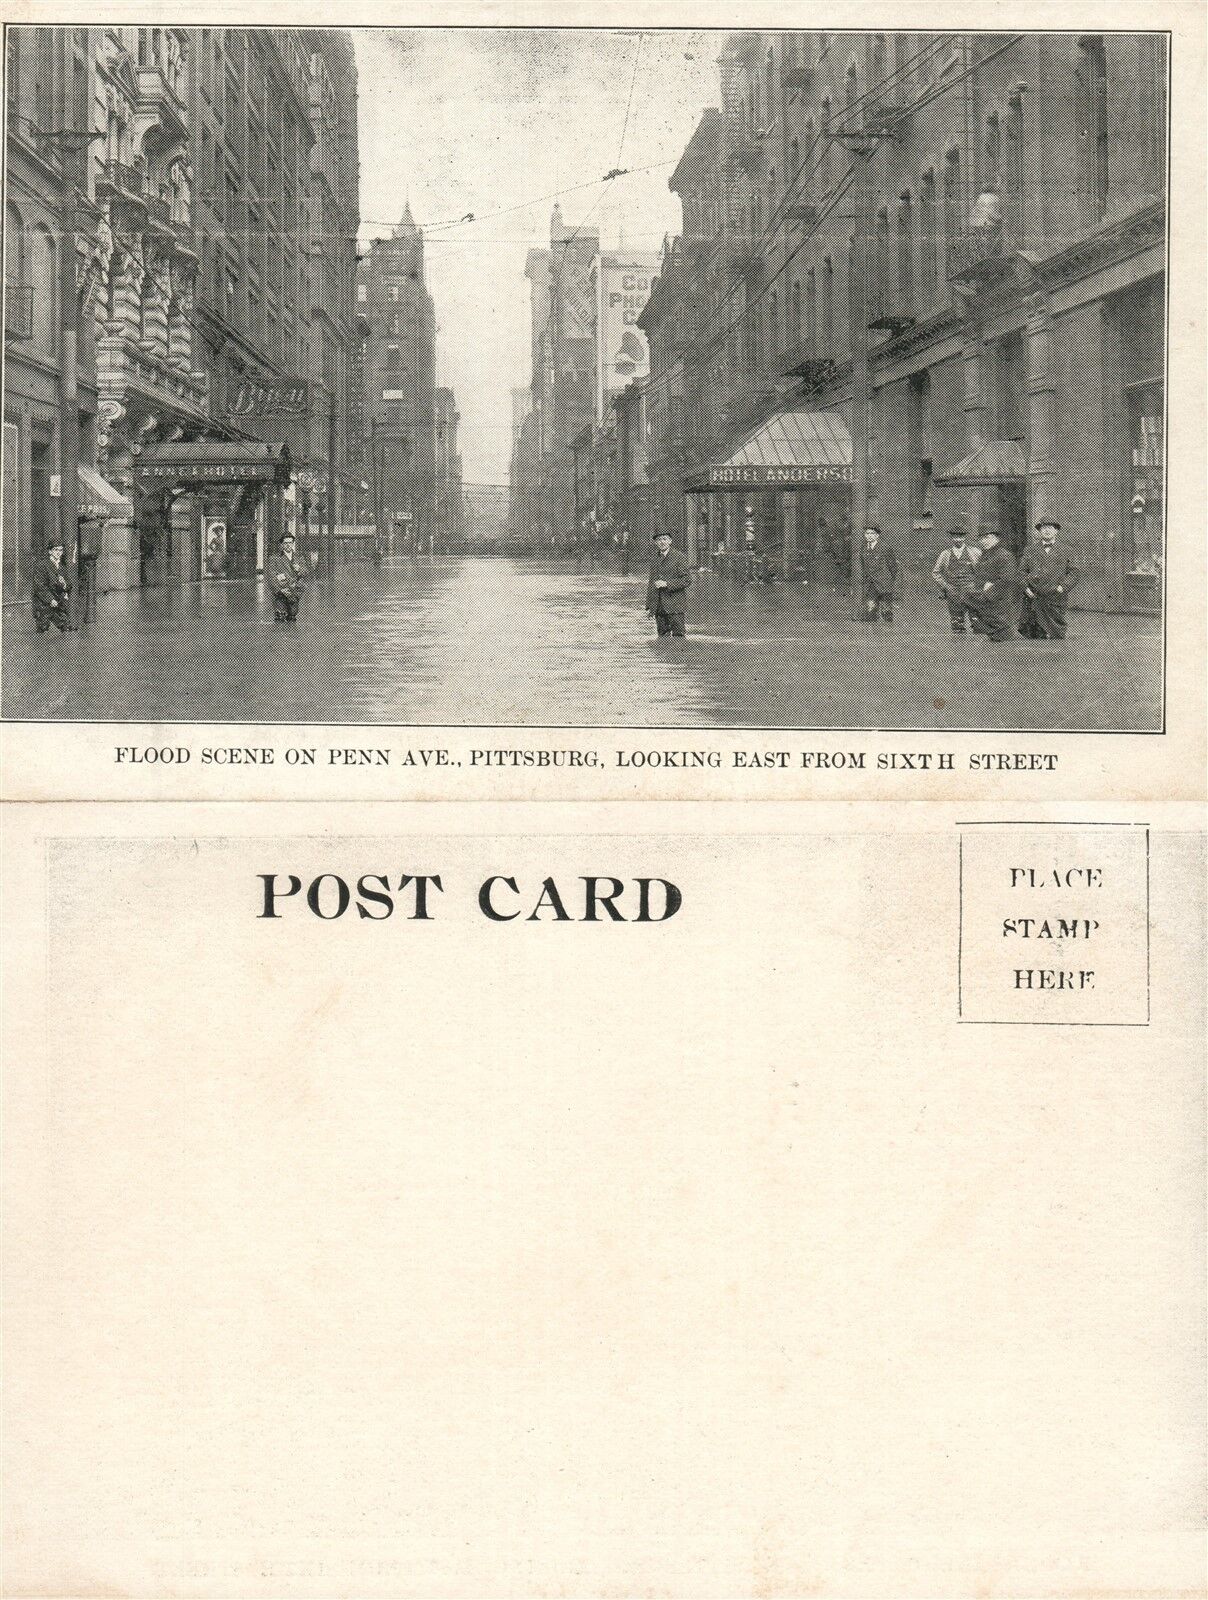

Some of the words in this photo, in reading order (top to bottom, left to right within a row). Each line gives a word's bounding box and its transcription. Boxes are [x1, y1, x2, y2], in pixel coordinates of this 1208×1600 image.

[622, 274, 648, 291] CO
[609, 292, 646, 308] PHO
[622, 309, 638, 325] C
[712, 468, 759, 482] HOTEL
[765, 467, 855, 482] ANDERSO
[116, 747, 191, 764] FLOOD
[201, 748, 274, 764] SCENE
[285, 749, 315, 765] ON
[329, 749, 391, 765] PENN
[402, 750, 461, 768] AVE.,
[470, 750, 605, 769] PITTSBURG,
[616, 751, 721, 768] LOOKING
[732, 751, 790, 768] EAST
[802, 752, 866, 769] FROM
[877, 753, 954, 769] SIXTH
[969, 753, 1058, 770] STREET
[1010, 868, 1104, 888] PLACE
[256, 873, 444, 920] POST
[478, 875, 682, 922] CARD
[1003, 918, 1101, 939] STAMP
[1014, 969, 1096, 990] HERE
